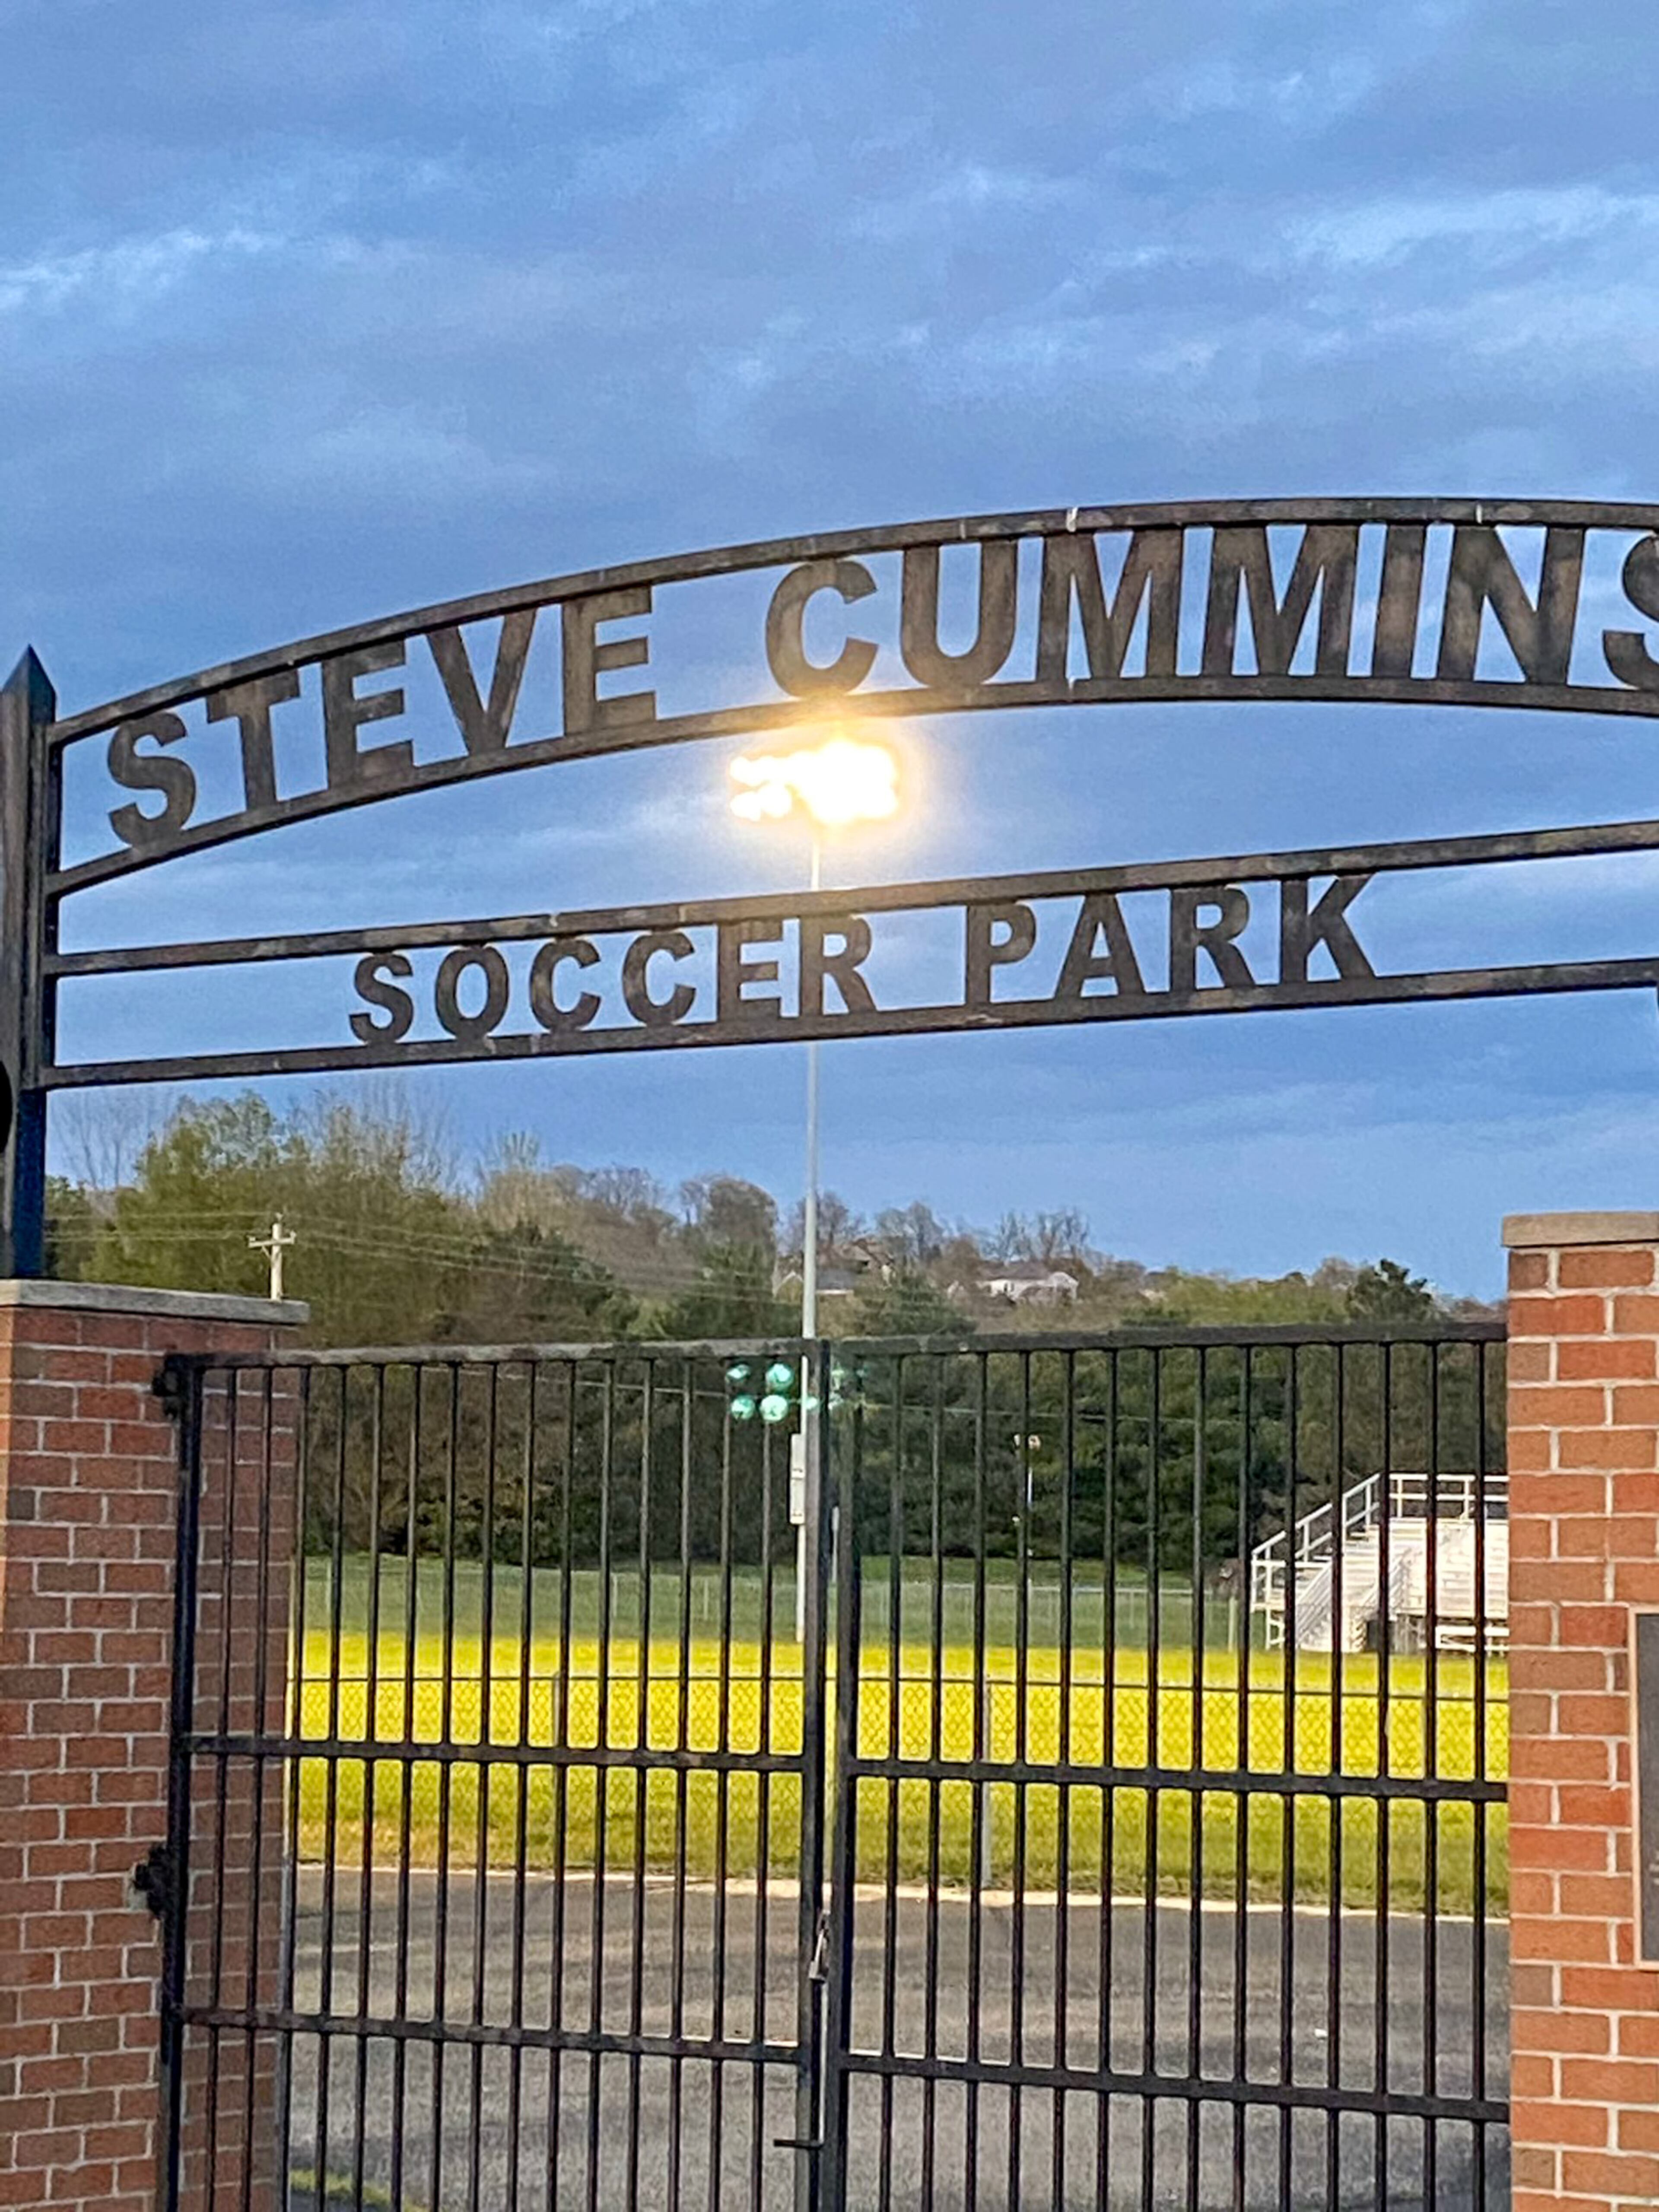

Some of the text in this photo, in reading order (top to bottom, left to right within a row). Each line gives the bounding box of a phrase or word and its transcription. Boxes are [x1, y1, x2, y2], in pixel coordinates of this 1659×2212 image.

[107, 585, 656, 852] STEVE
[349, 874, 1377, 1046] SOCCER PARK
